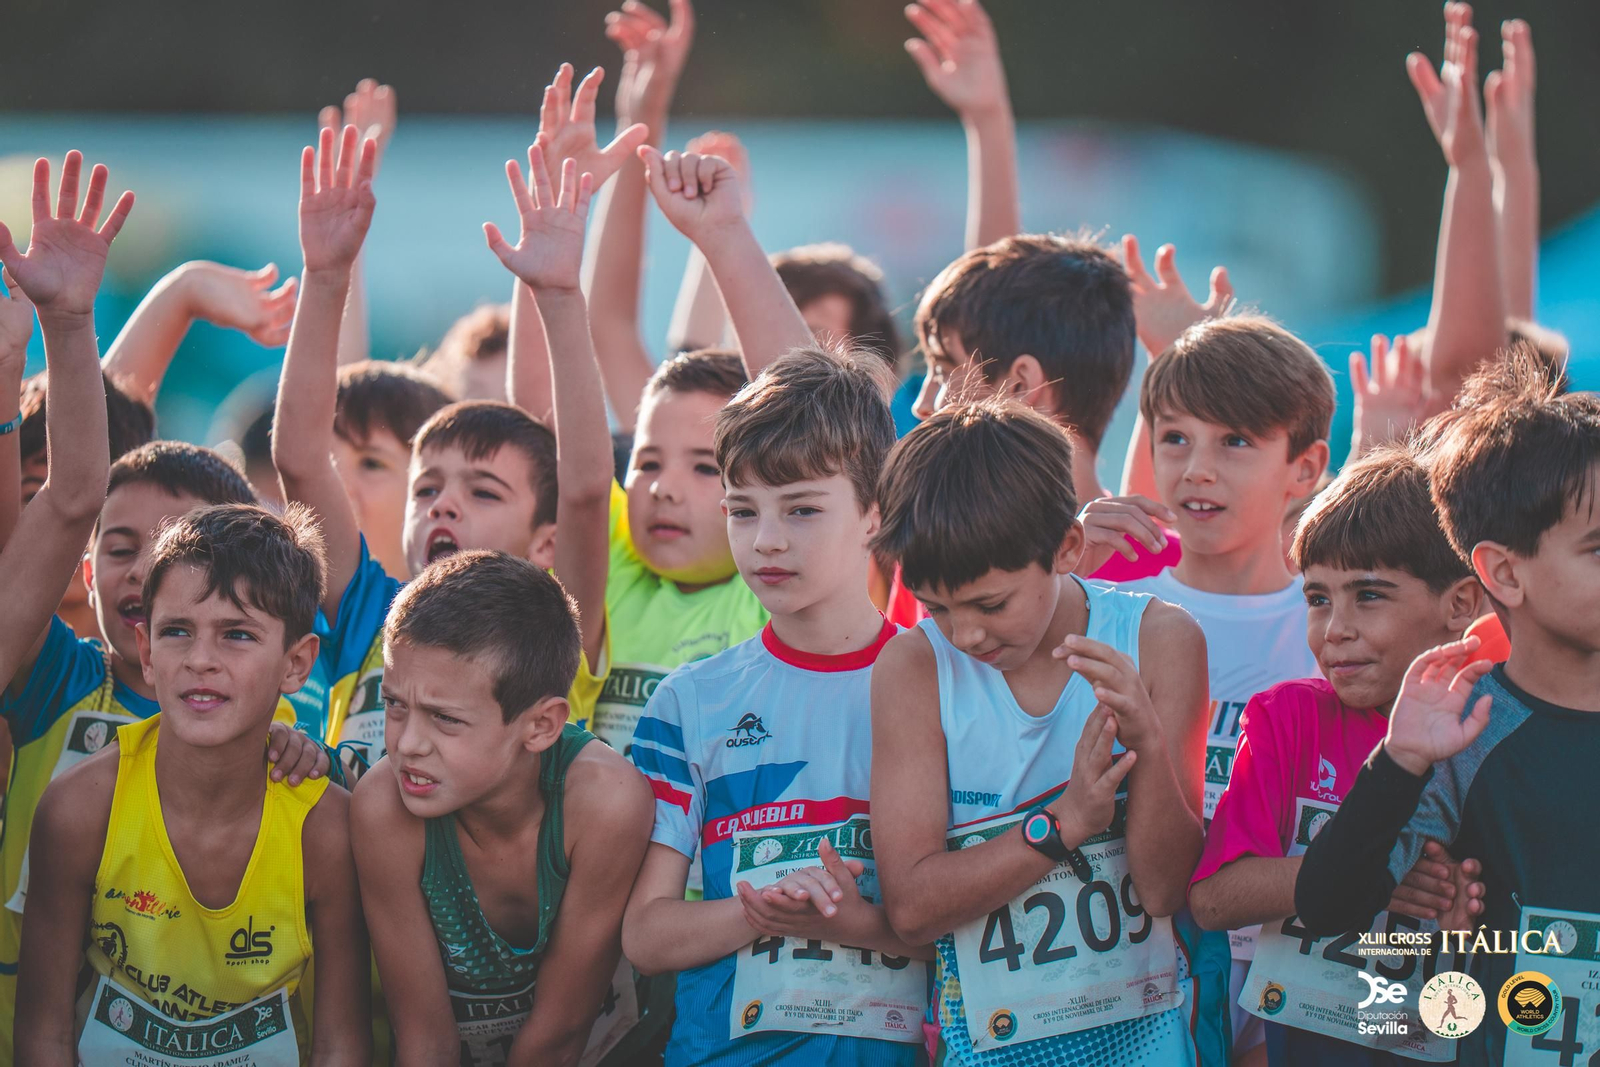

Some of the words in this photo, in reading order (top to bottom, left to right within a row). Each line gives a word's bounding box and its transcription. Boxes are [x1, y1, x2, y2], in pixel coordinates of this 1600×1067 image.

[951, 789, 1002, 807] DISPORT
[1053, 863, 1102, 882] TOMES
[979, 872, 1152, 972] 4209
[124, 965, 171, 993] CLUB
[775, 1004, 793, 1012] CROSS
[793, 1004, 837, 1015] INTERNACIONAL
[1315, 1005, 1359, 1023] INTERNACIONA
[143, 1020, 244, 1052] ITÁLICA
